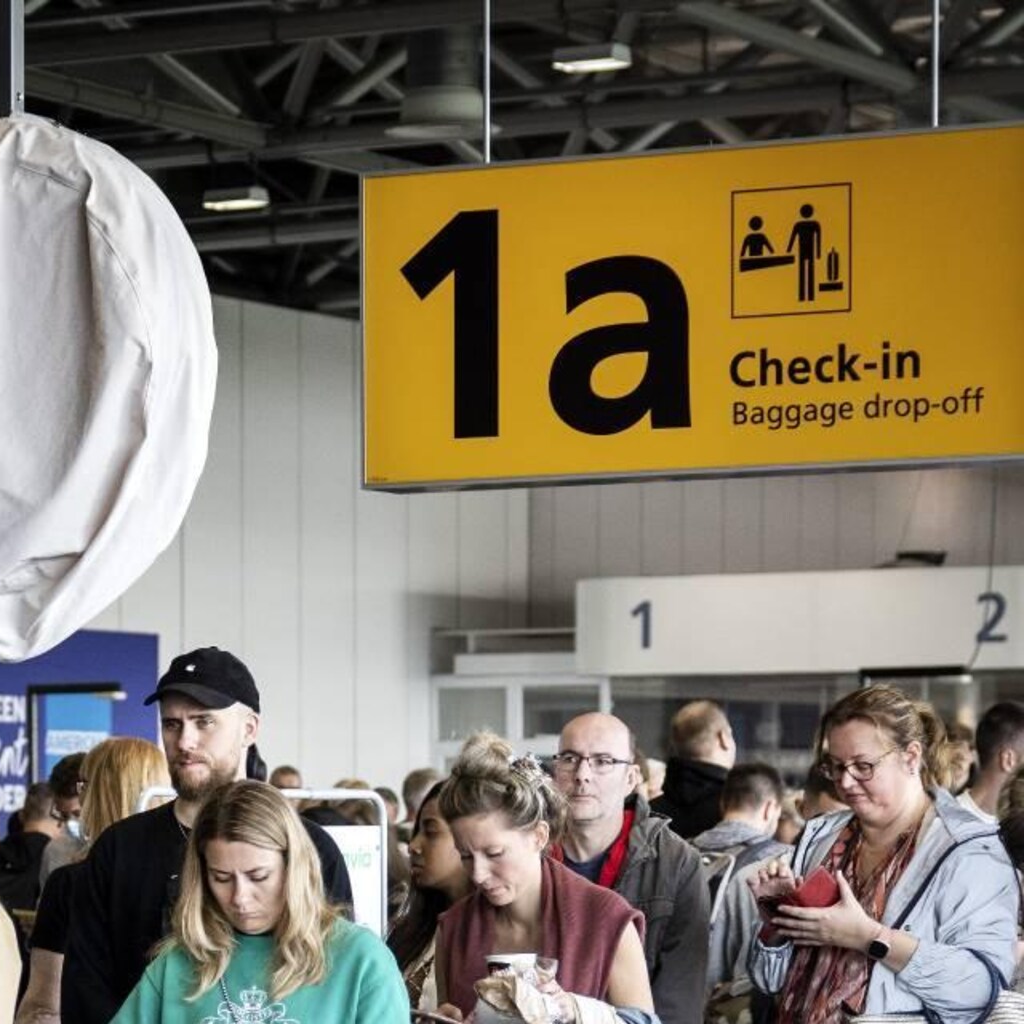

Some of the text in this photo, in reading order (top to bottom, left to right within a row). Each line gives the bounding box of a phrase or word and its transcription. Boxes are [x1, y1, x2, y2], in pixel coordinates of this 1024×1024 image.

[400, 208, 692, 440] 1a
[729, 341, 921, 388] Check-in
[732, 386, 985, 431] Baggage drop-off
[631, 600, 652, 649] 1
[976, 591, 1008, 643] 2
